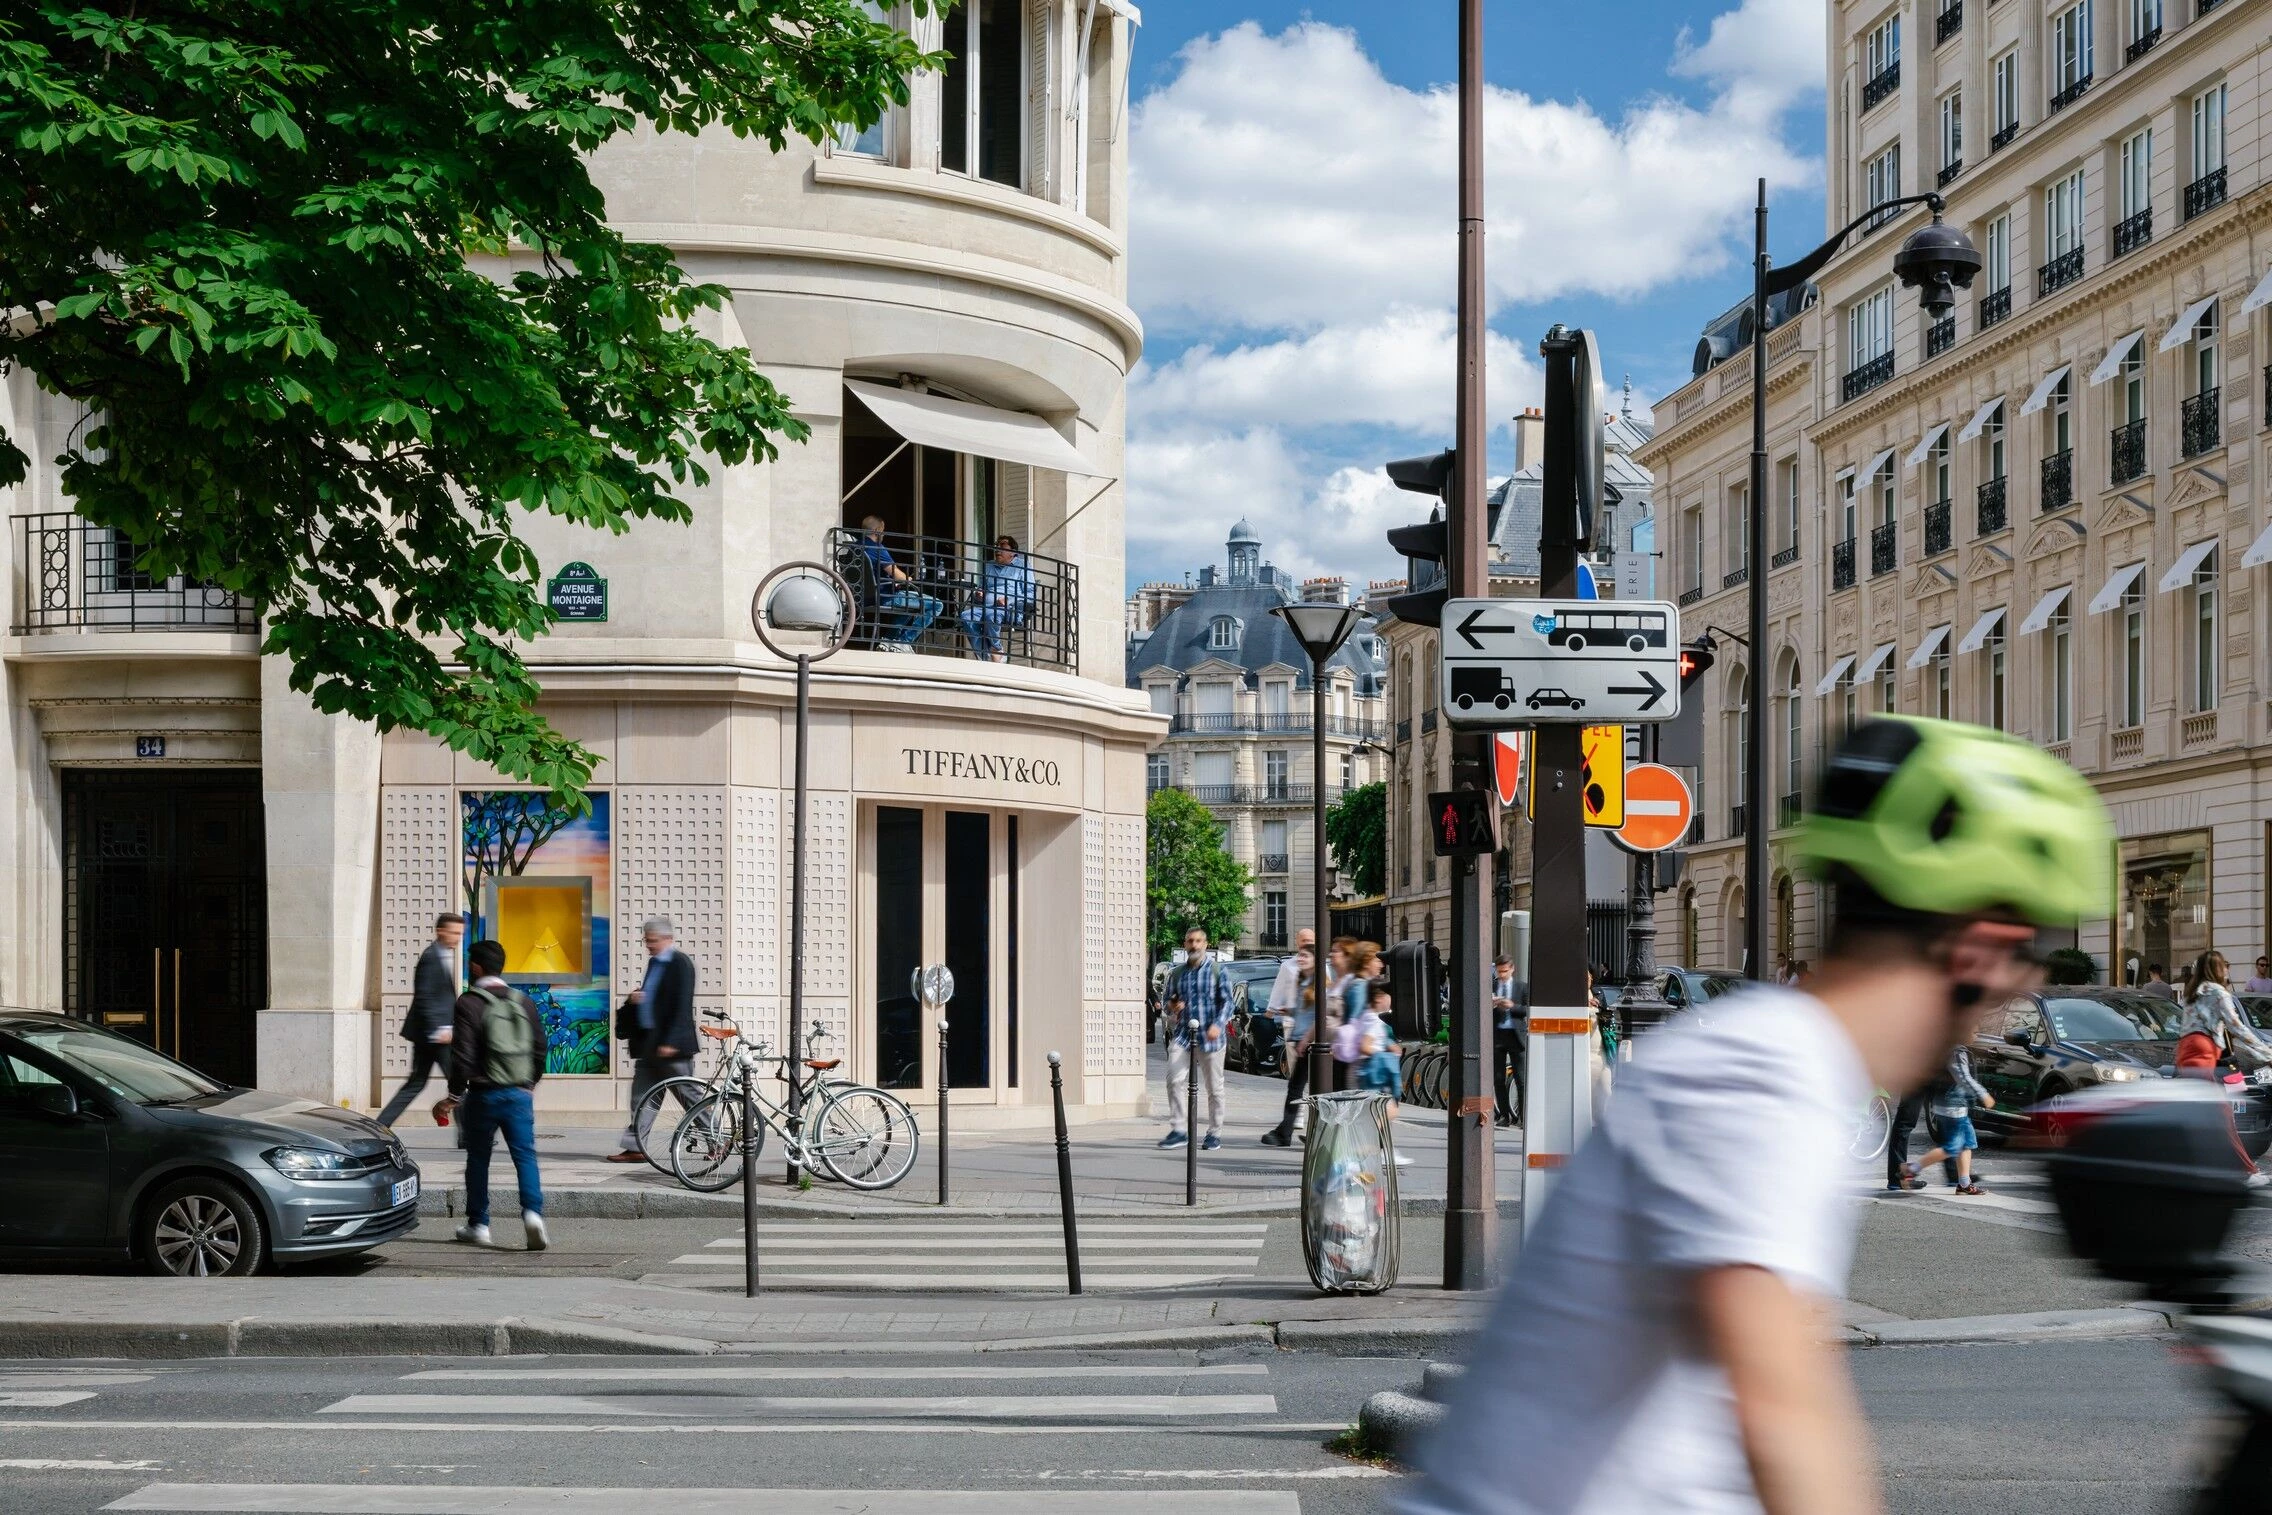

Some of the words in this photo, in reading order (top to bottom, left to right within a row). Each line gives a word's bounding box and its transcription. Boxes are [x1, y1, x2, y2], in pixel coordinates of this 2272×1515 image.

[1628, 560, 1638, 600] ERIE
[560, 584, 594, 594] AVENUE
[552, 596, 602, 604] MONTAIGNE
[140, 739, 162, 754] 34
[901, 748, 1061, 786] TIFFANY&CO.
